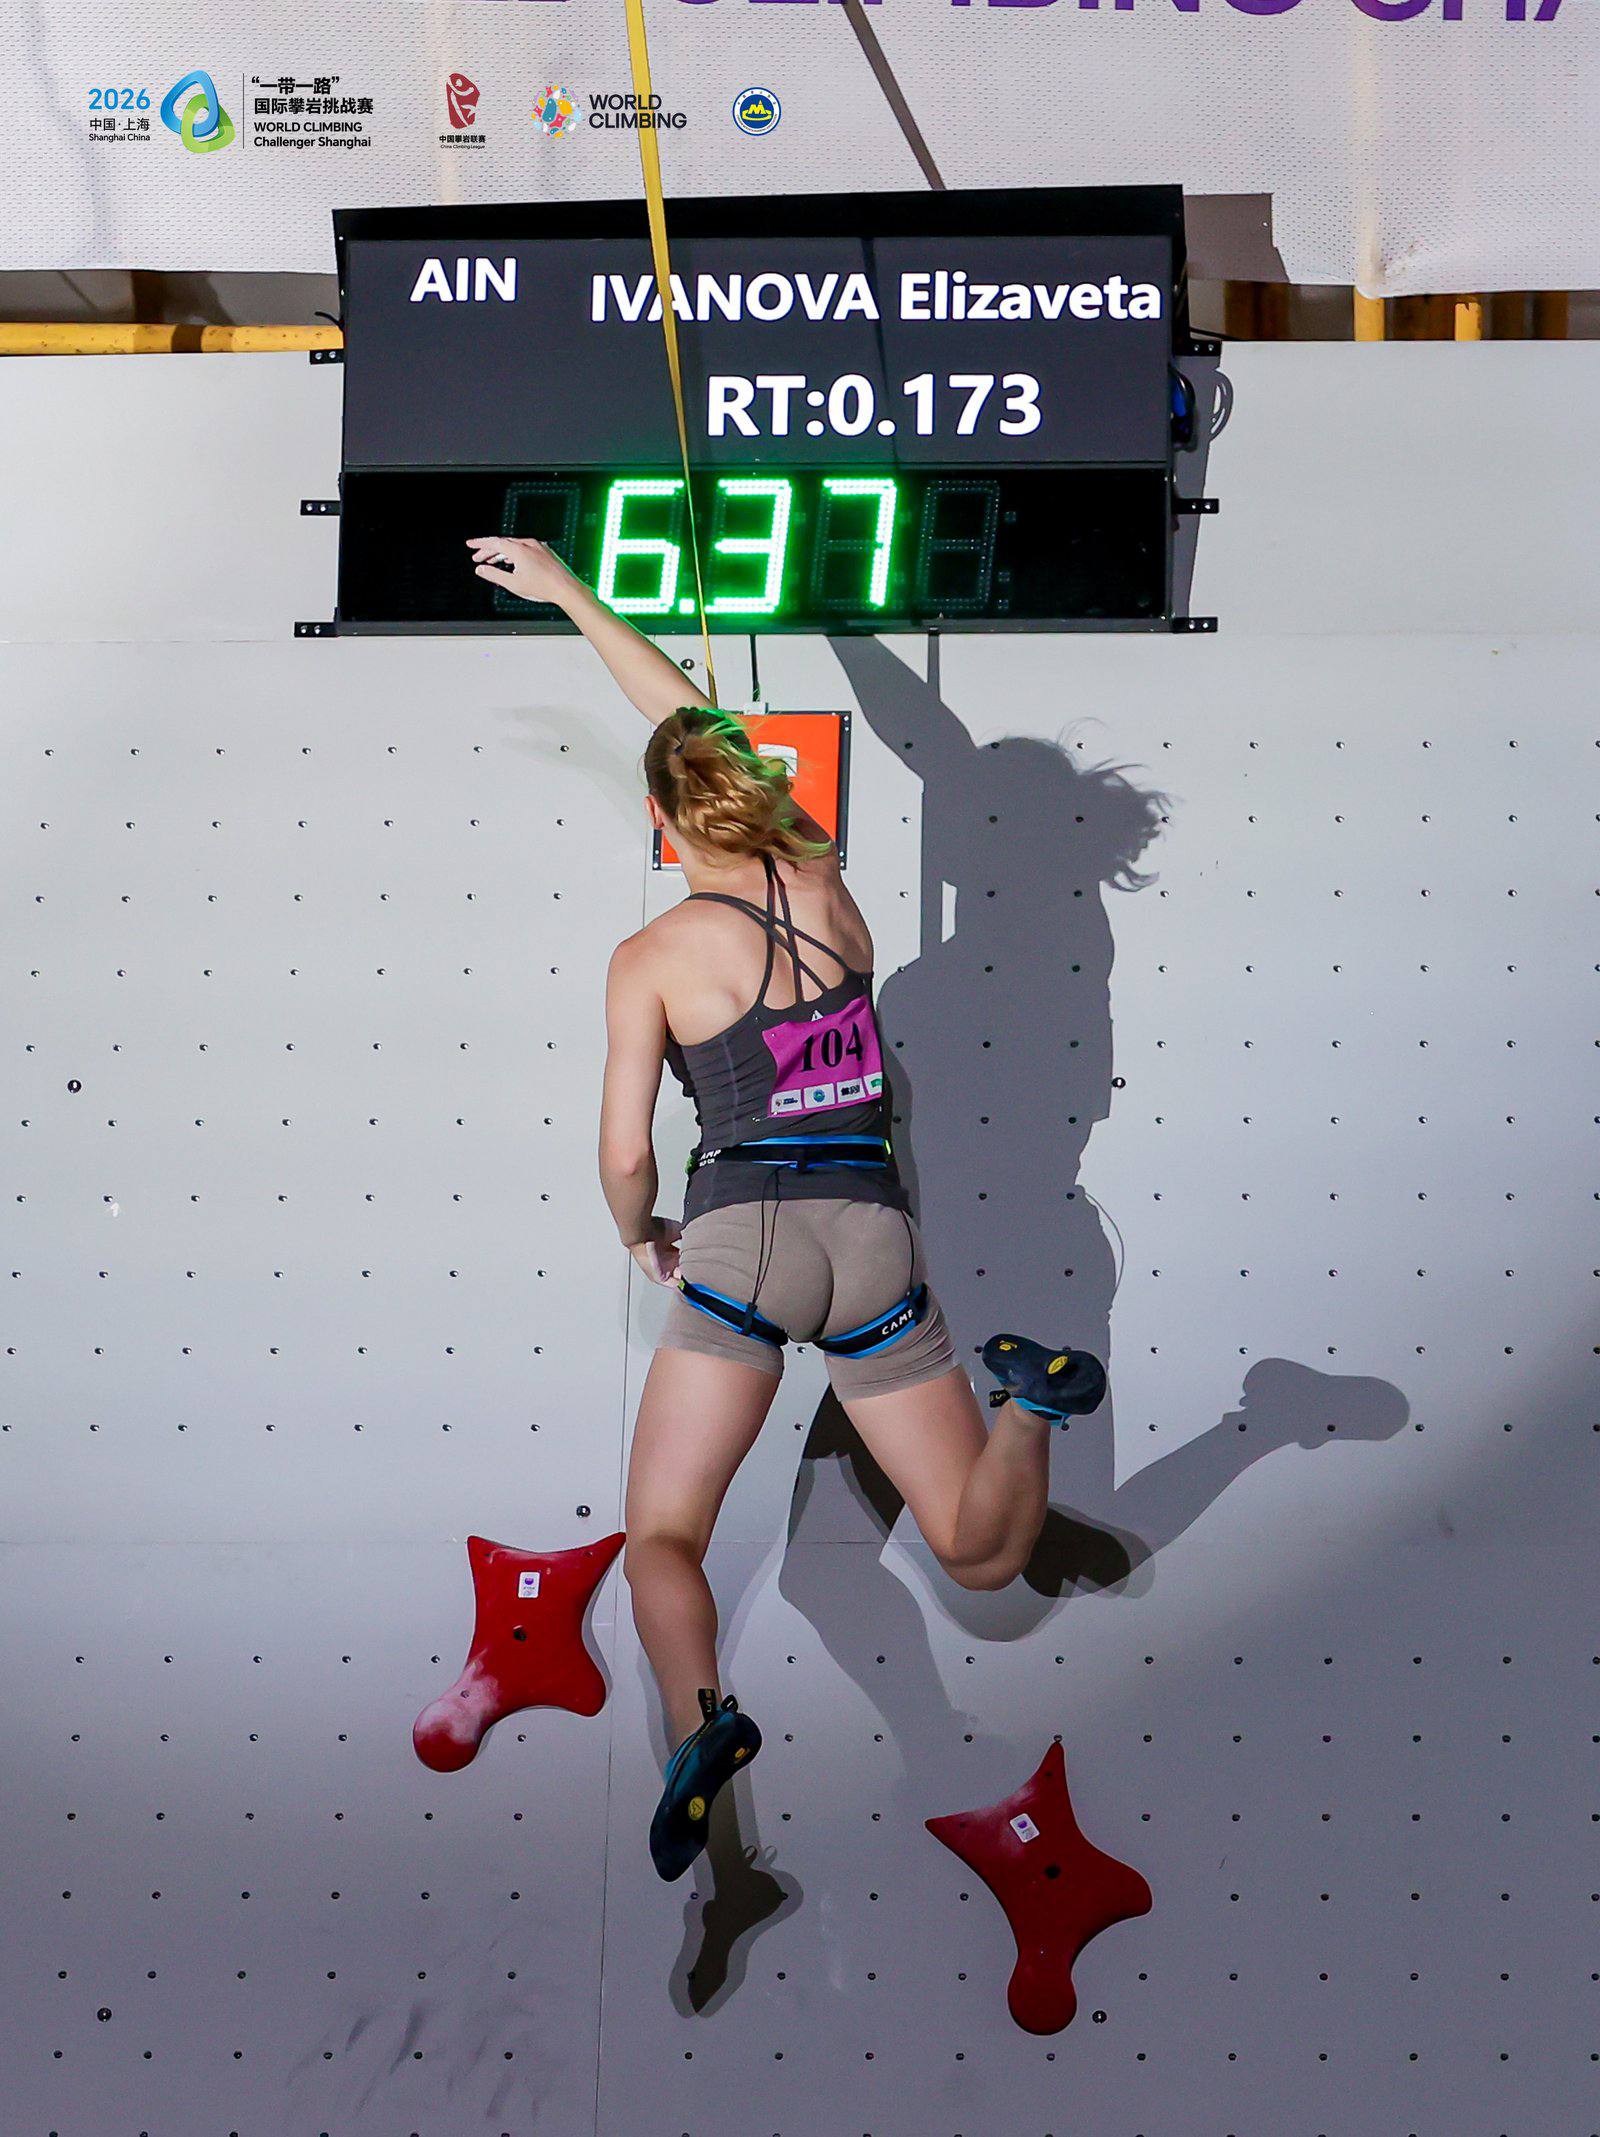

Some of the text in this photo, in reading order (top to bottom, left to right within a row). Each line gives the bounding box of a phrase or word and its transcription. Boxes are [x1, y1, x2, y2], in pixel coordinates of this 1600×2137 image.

[410, 257, 517, 302] AIN
[591, 270, 1162, 322] IVANOVA Elizaveta
[707, 373, 1042, 437] RT:0.173
[597, 478, 898, 614] 6.37
[800, 1021, 863, 1072] 104
[881, 1308, 914, 1335] CAMP
